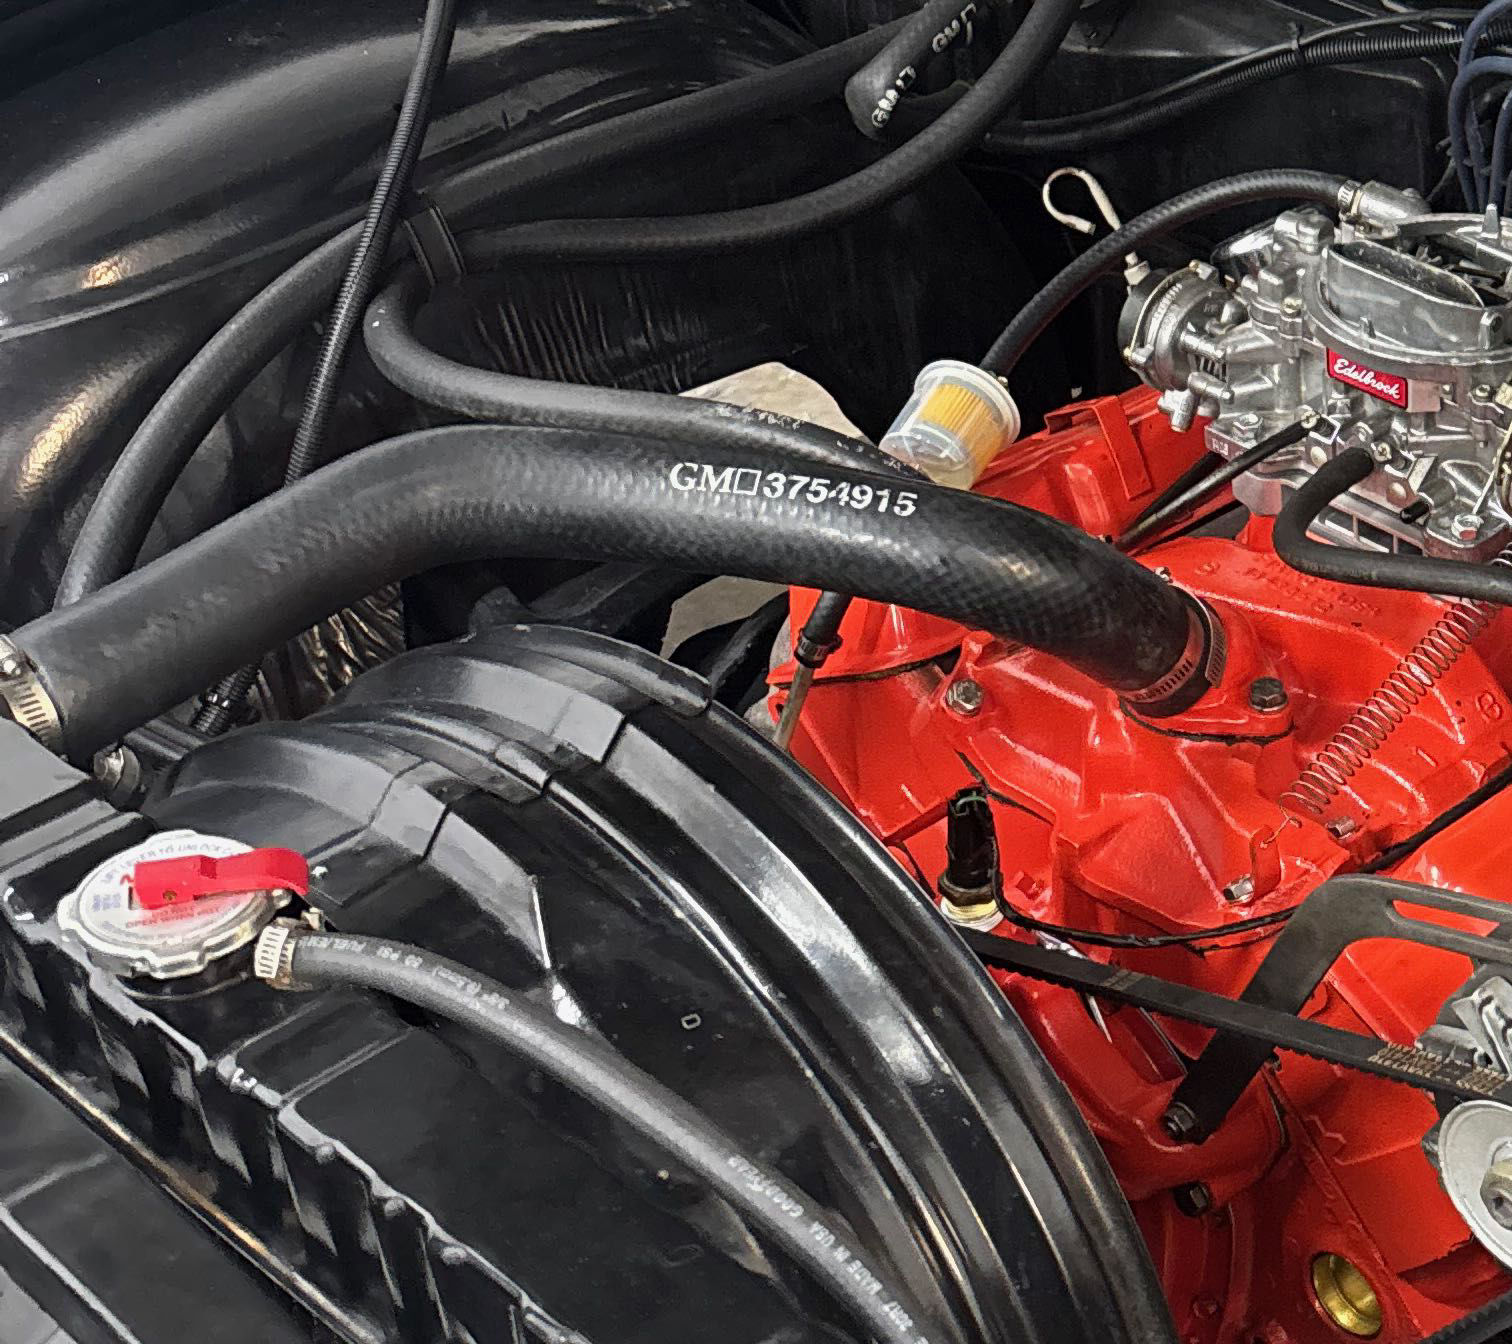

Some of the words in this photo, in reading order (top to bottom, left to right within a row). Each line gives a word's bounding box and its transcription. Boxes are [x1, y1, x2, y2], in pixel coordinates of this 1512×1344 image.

[1333, 358, 1401, 399] Edelbrock
[808, 1220, 836, 1248] USA
[848, 1259, 883, 1296] MADE
